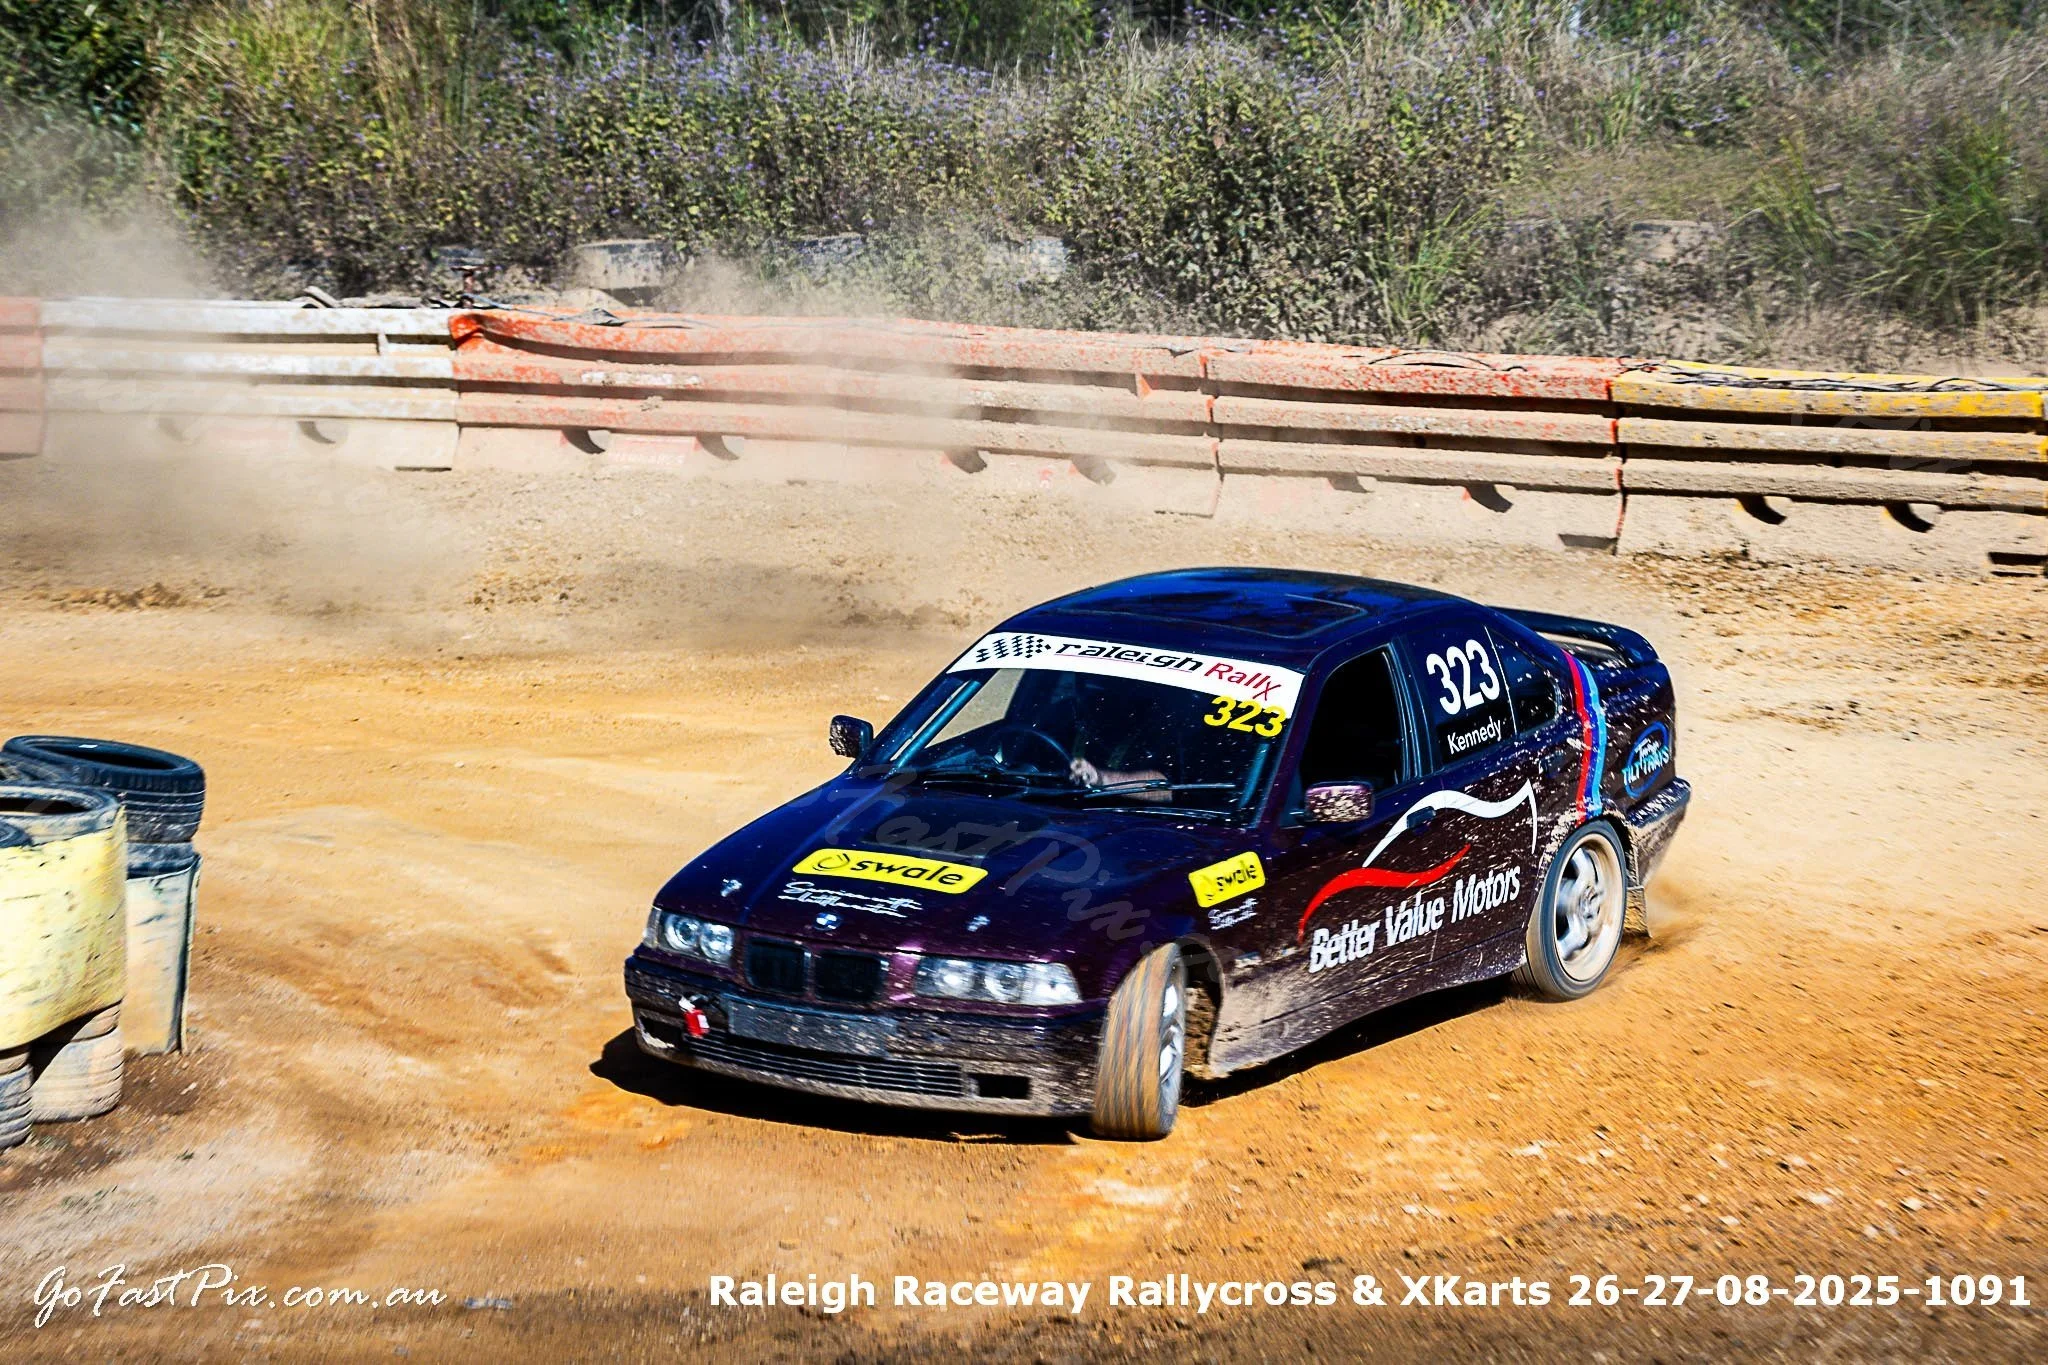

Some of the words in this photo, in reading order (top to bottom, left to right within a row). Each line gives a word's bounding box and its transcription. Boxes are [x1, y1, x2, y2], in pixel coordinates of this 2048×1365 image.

[1055, 643, 1203, 672] raleigh
[1426, 639, 1500, 715] 323
[1203, 695, 1287, 738] 323
[1447, 717, 1502, 755] Kennedy
[851, 857, 964, 886] swale
[1308, 921, 1380, 973] Better
[1385, 891, 1445, 947] Value
[1451, 866, 1521, 924] Motors
